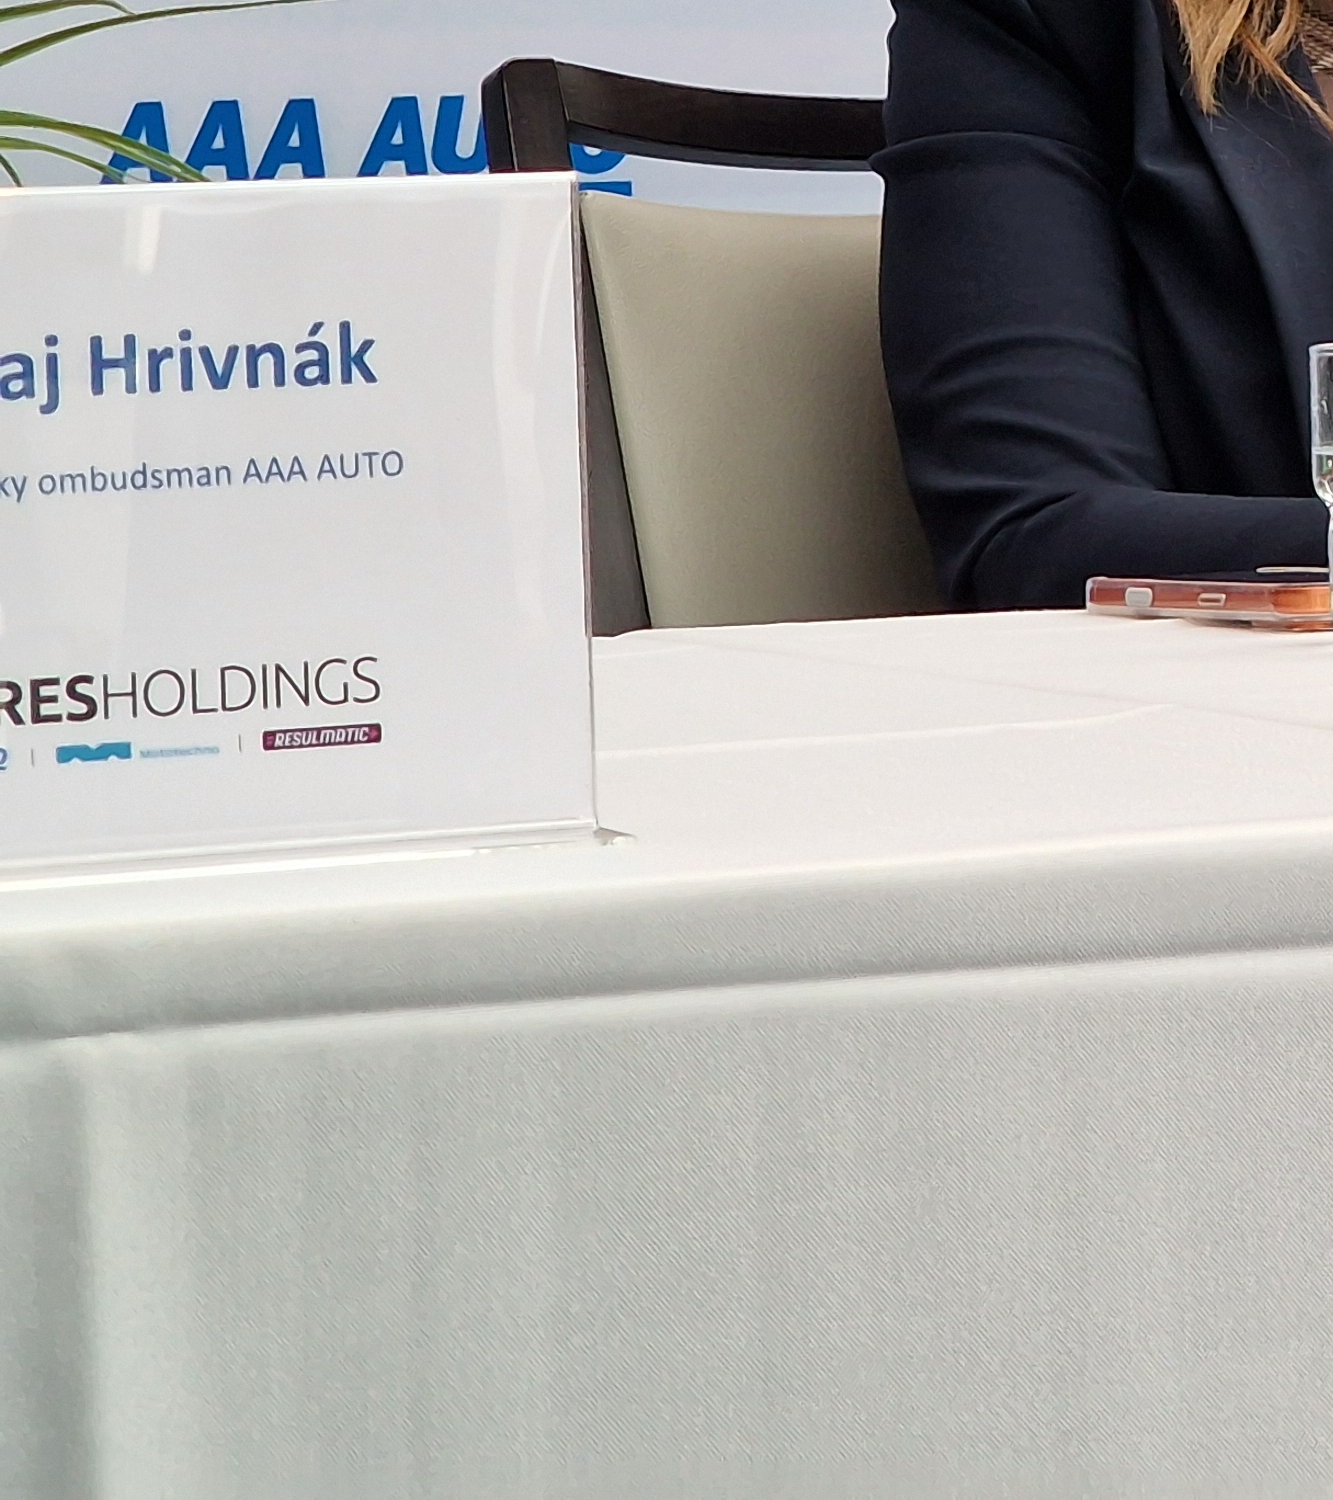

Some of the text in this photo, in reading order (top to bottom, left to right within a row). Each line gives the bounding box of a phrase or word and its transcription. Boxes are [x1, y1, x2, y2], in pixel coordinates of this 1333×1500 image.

[100, 98, 327, 183] AAA
[89, 319, 379, 397] Hrivnák
[37, 461, 232, 496] ombudsman
[242, 455, 308, 485] AAA
[316, 449, 404, 482] AUTO
[274, 727, 370, 747] RESULMATIC
